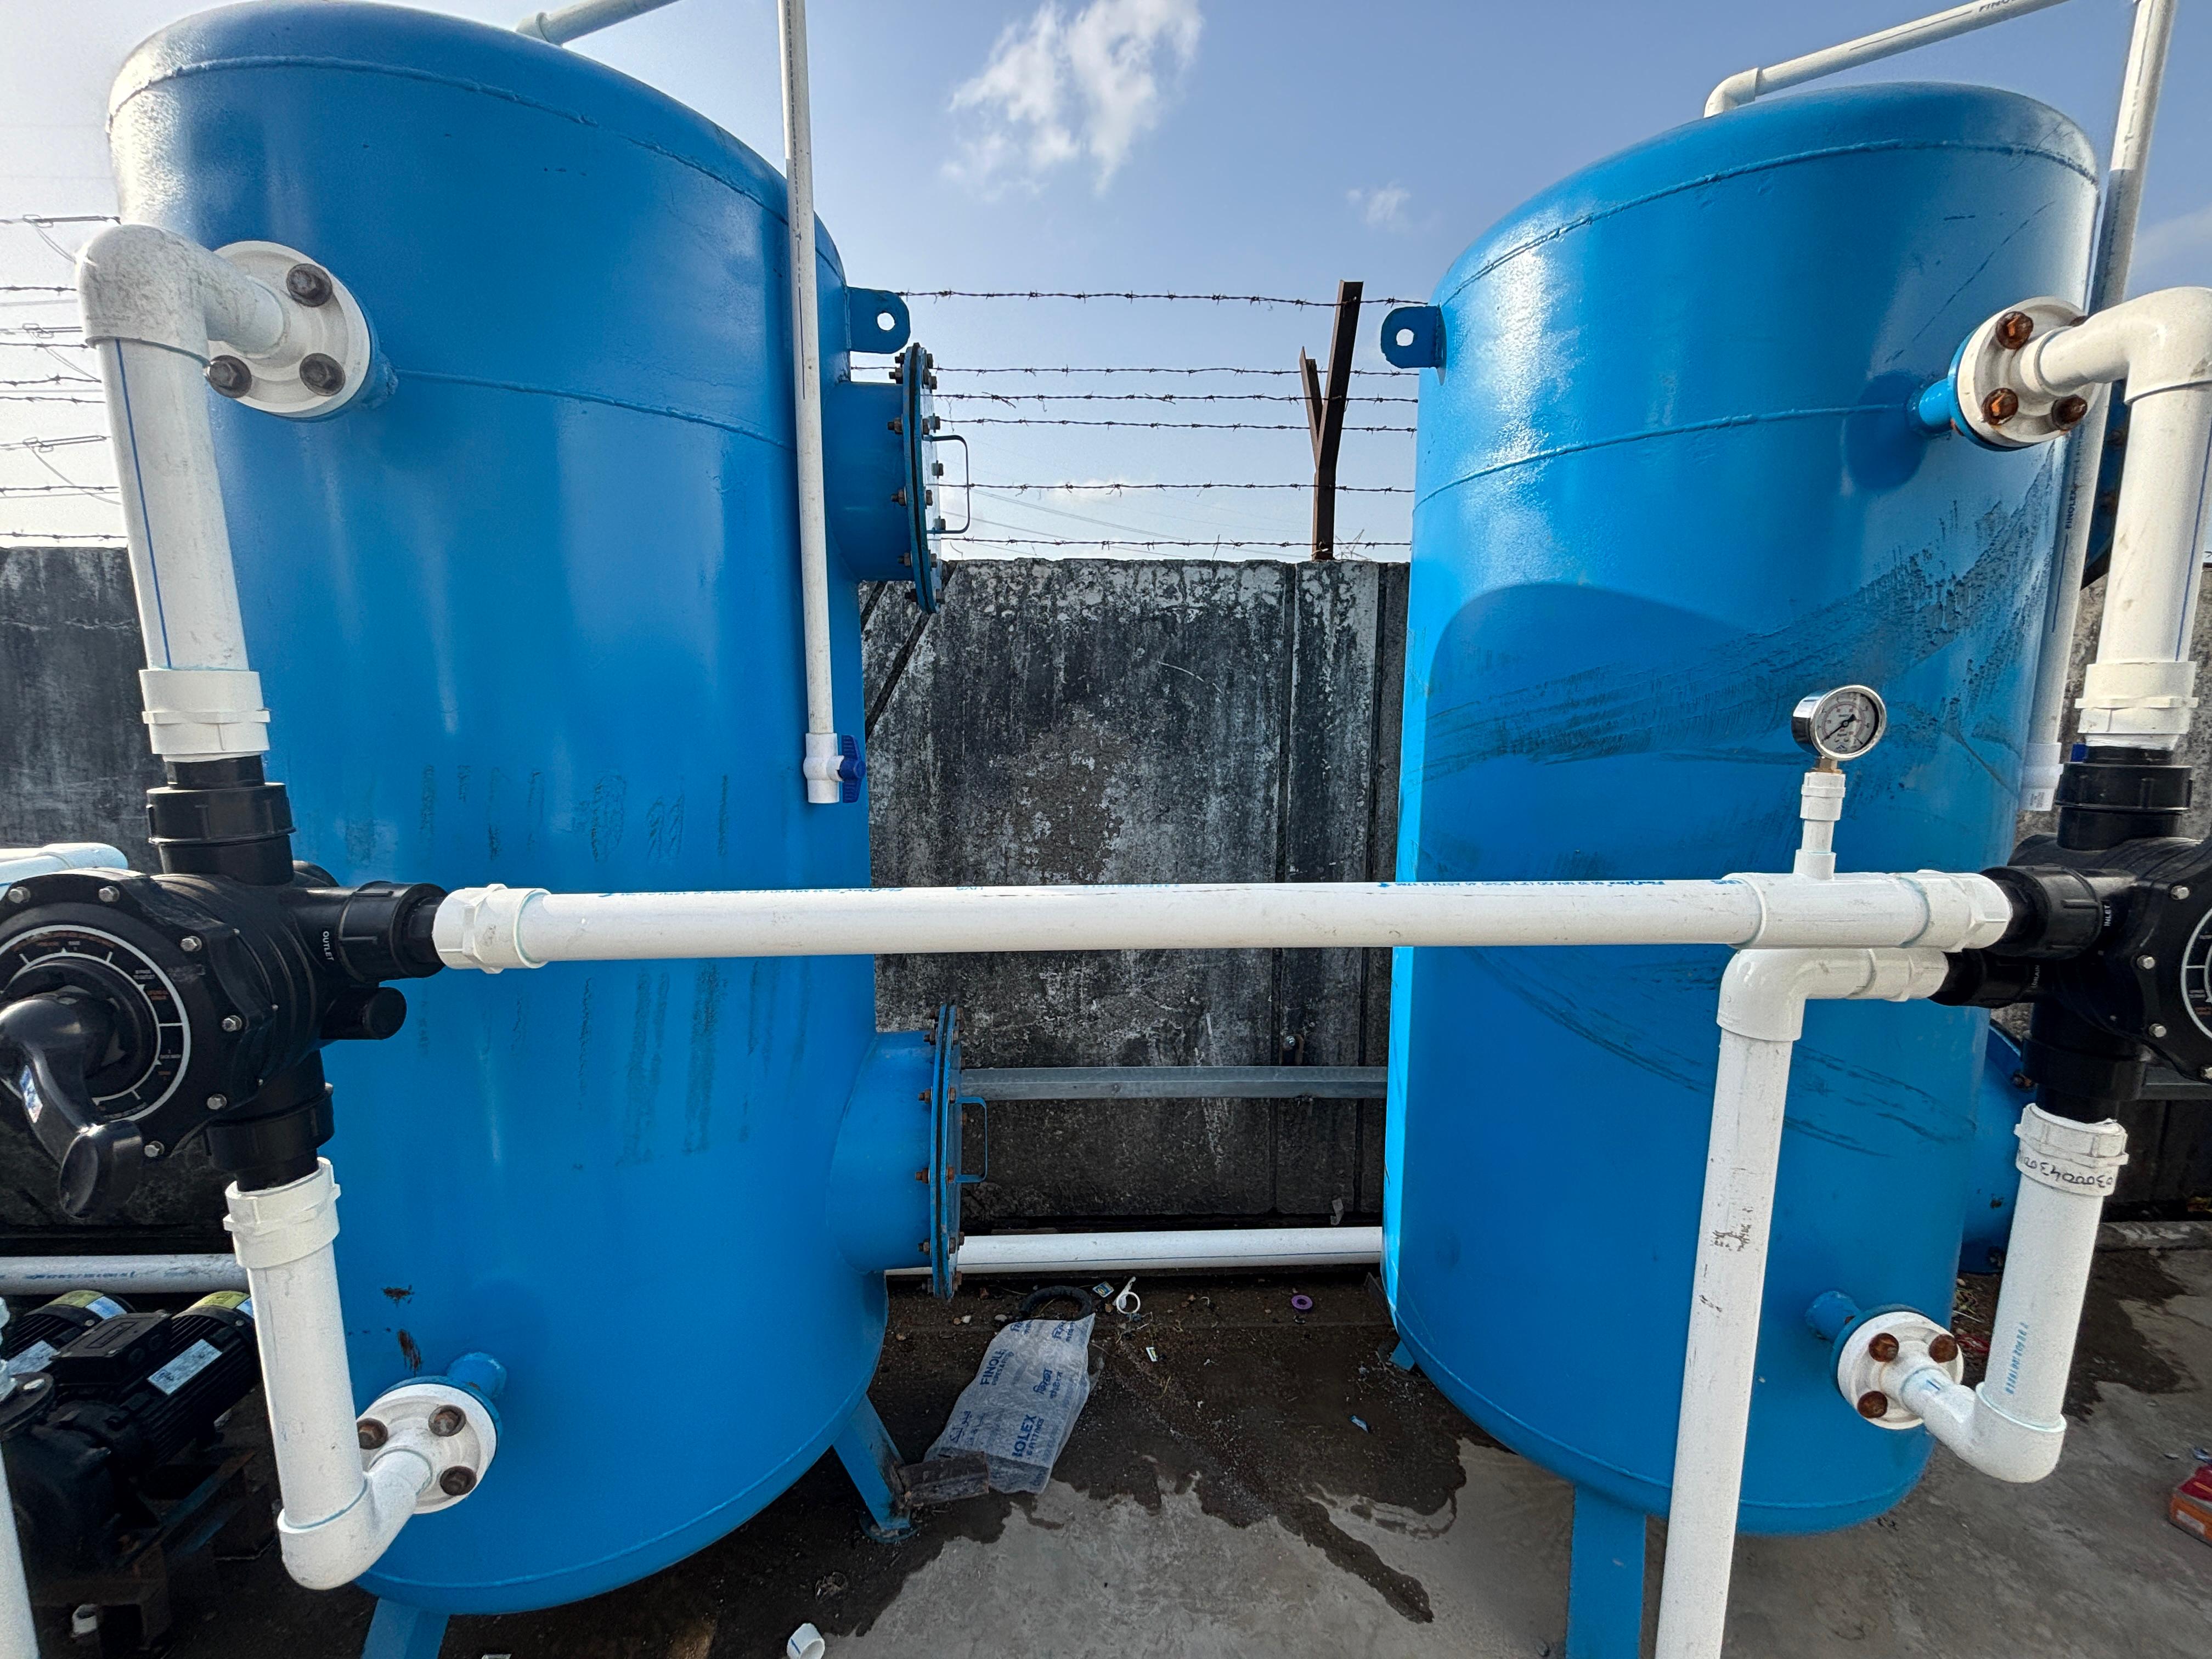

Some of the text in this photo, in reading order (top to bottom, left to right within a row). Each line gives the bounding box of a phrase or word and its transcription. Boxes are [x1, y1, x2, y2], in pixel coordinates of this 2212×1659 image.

[2065, 489, 2076, 529] FINOLEX
[2103, 904, 2112, 927] INLET
[323, 930, 335, 961] OUTLET
